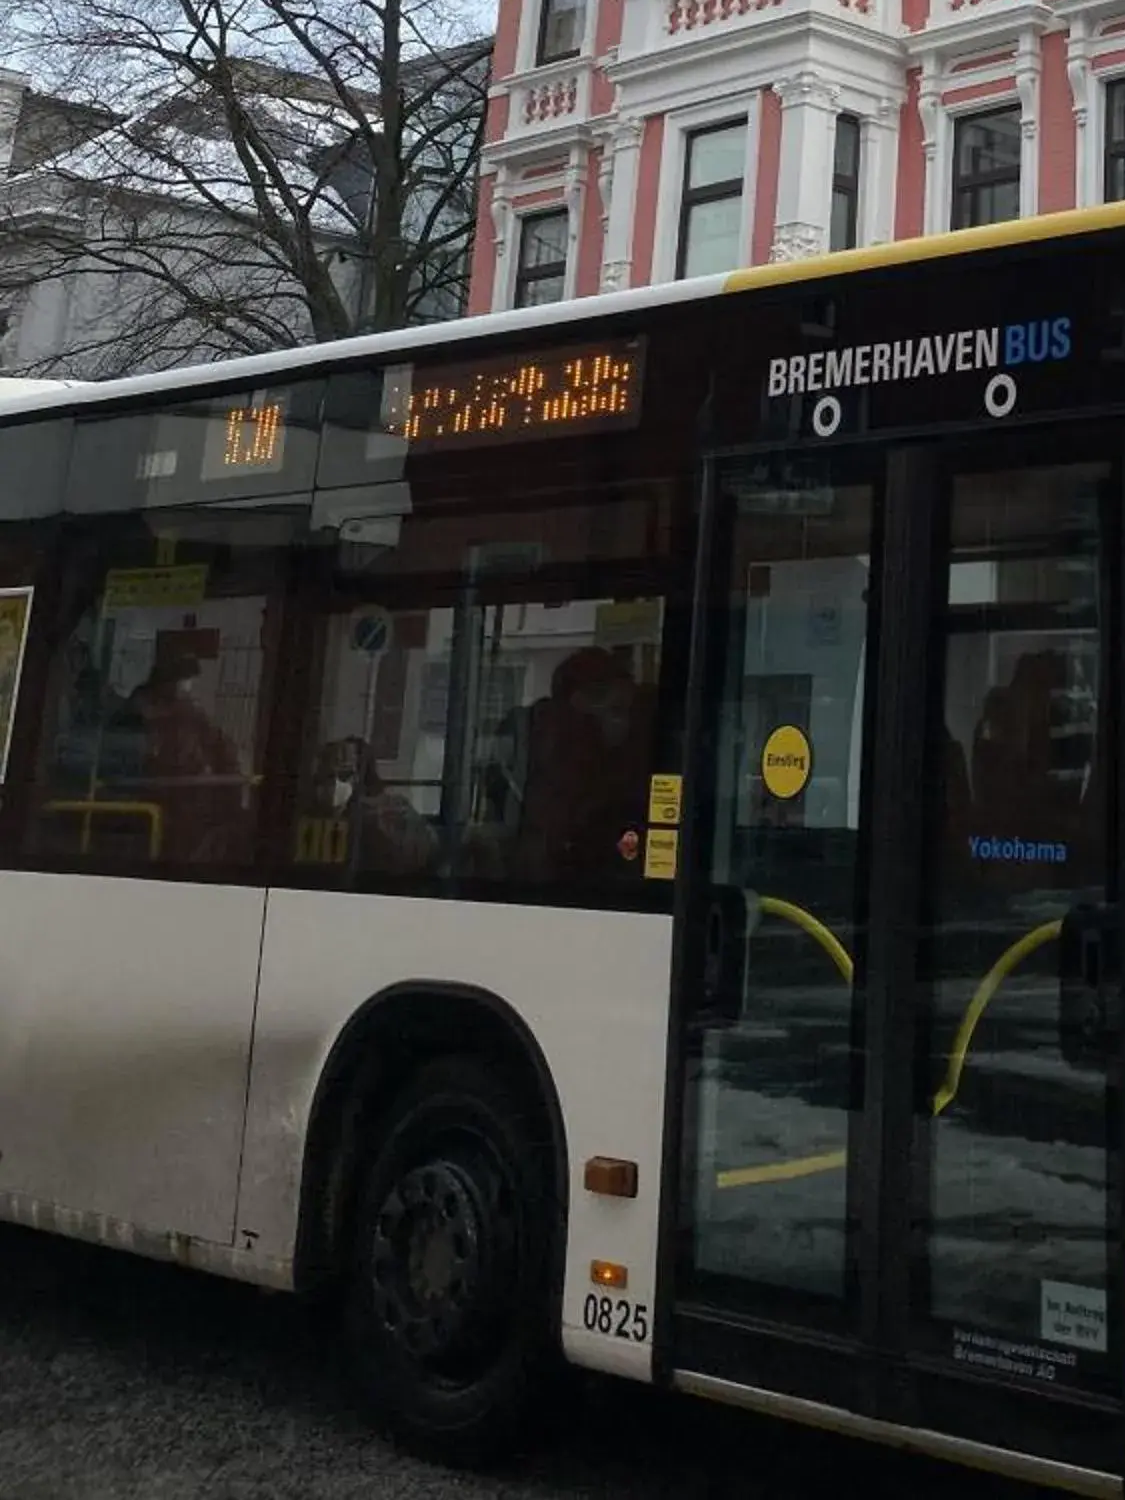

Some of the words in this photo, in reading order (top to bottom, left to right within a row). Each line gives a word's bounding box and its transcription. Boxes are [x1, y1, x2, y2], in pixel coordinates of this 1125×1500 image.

[768, 327, 999, 398] BREMERHAVEN
[1005, 317, 1071, 365] BUS
[968, 835, 1067, 862] Yokohama
[584, 1293, 647, 1342] 0825
